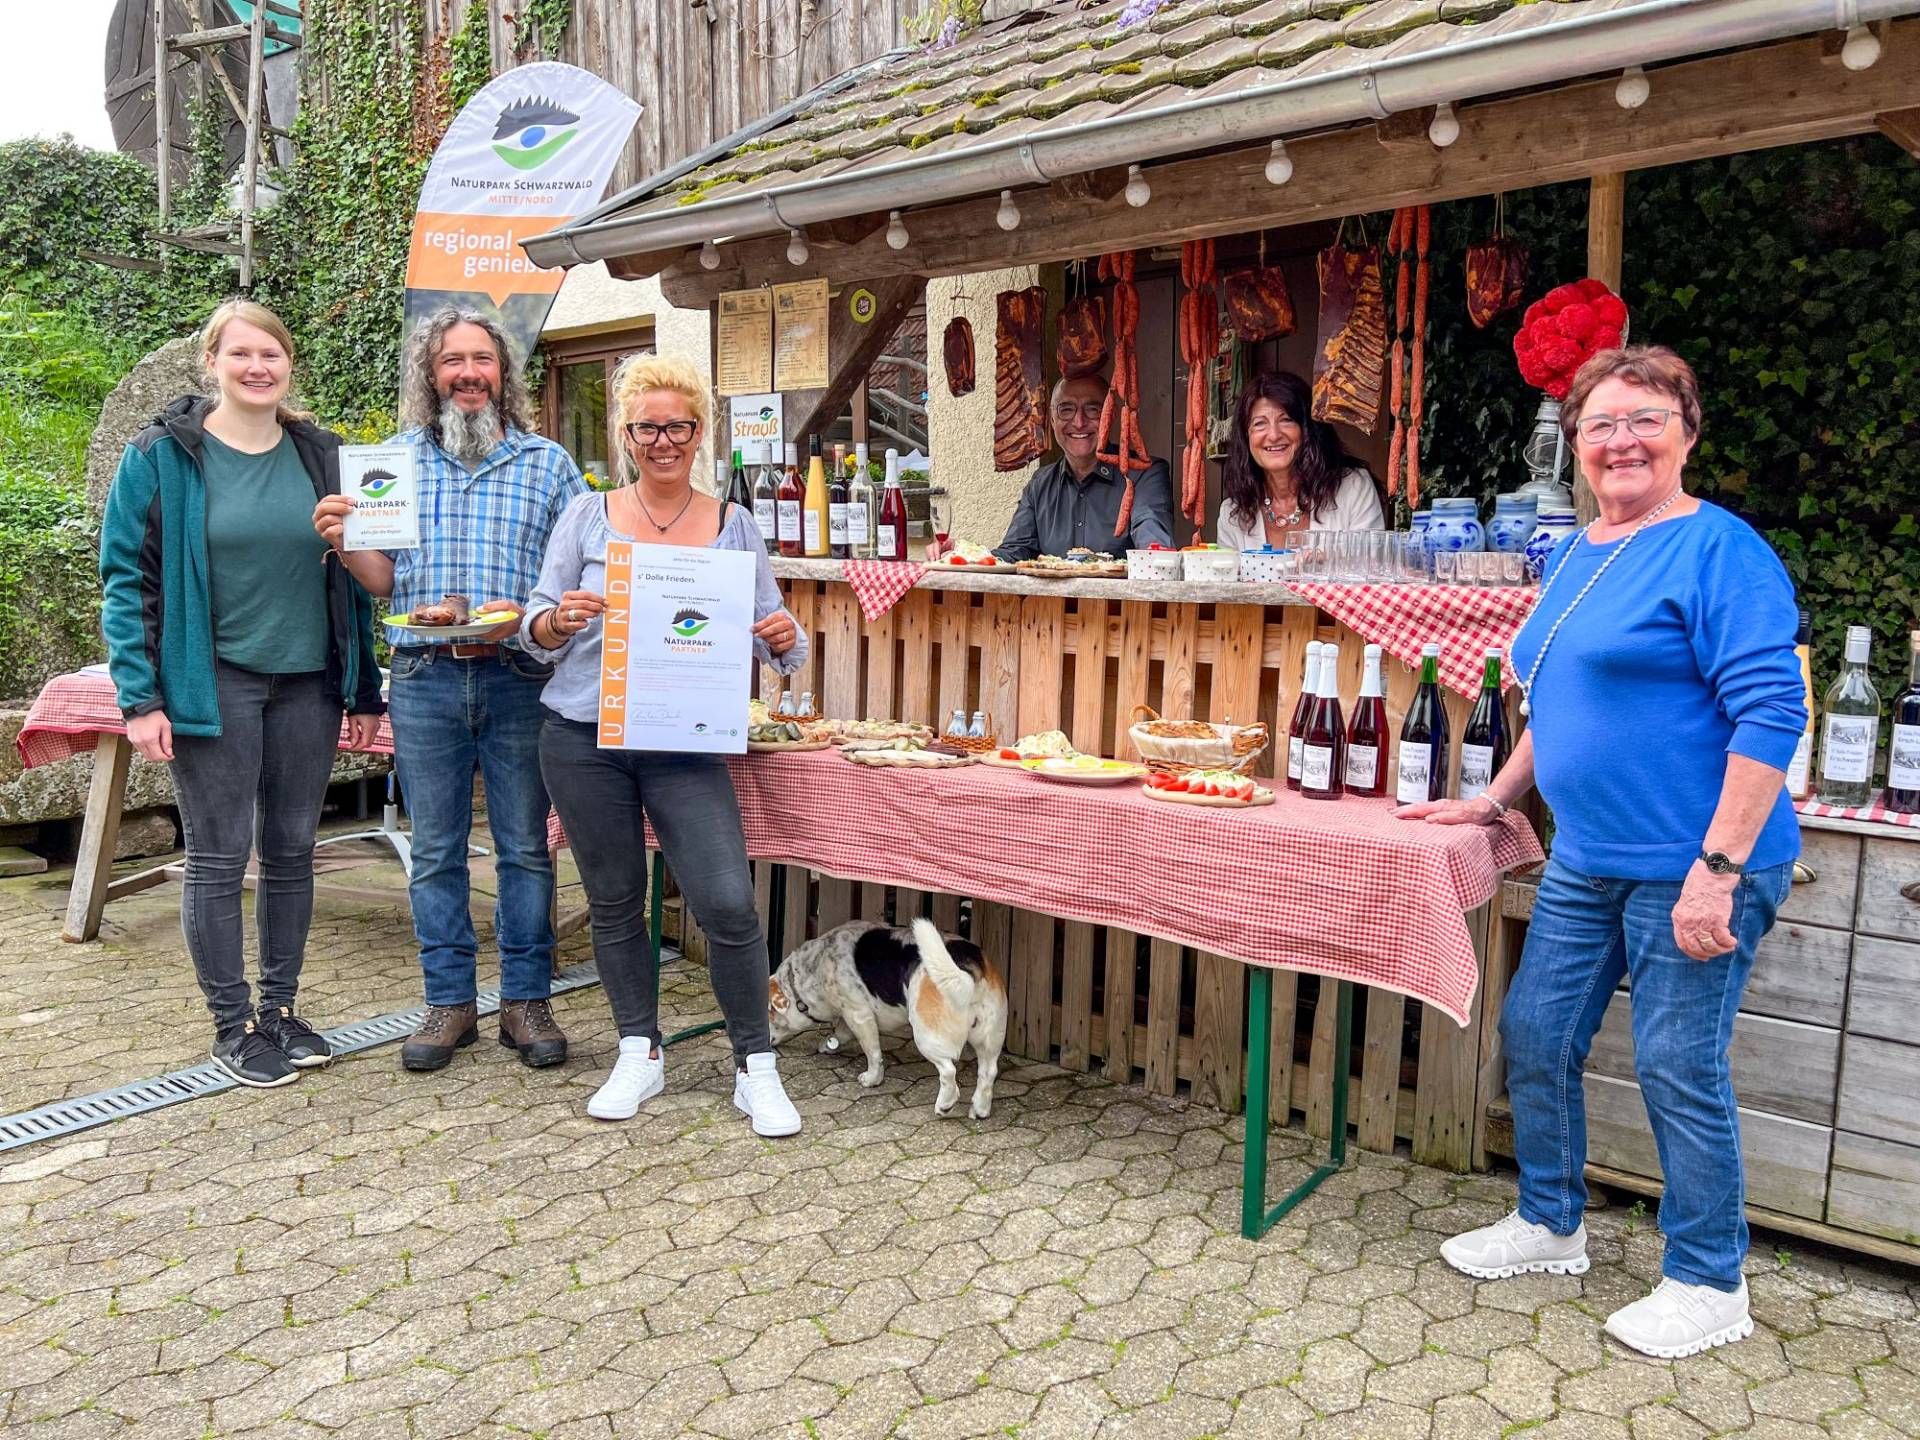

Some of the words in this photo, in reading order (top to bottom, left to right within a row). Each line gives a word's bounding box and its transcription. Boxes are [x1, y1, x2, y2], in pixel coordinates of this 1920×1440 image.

[451, 176, 511, 190] NATURPARK
[514, 179, 593, 191] SCHWARZWALD
[488, 194, 553, 205] MITTE/NORD
[424, 229, 513, 255] regional
[734, 417, 778, 437] Strauß
[352, 500, 410, 509] NATURPARK-
[360, 509, 400, 517] PARTNER
[645, 573, 664, 582] Dolle
[666, 575, 695, 584] Frieders
[603, 551, 631, 737] URKUNDE
[664, 637, 716, 647] NATURPARK-
[671, 646, 707, 654] PARTNER
